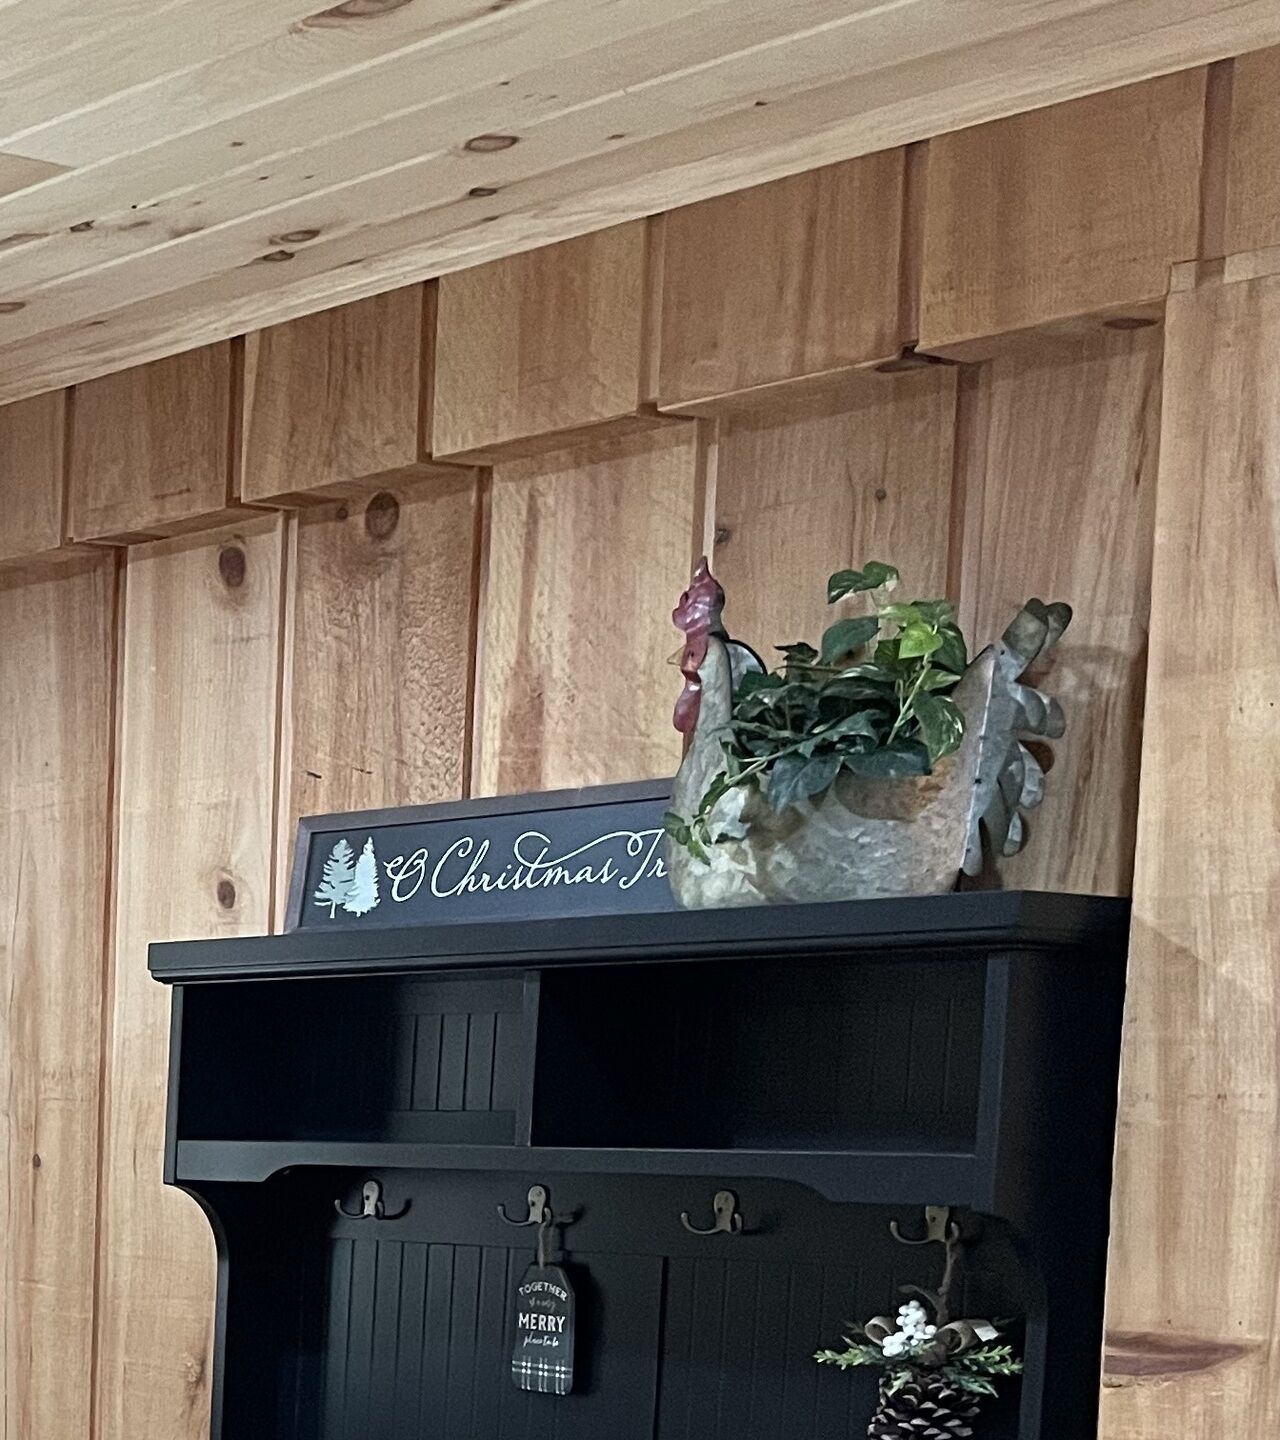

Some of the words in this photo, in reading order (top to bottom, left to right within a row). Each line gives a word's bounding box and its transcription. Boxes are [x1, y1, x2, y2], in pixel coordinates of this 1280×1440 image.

[430, 830, 619, 898] Christmas
[518, 1281, 567, 1301] TOGETHER
[518, 1312, 565, 1333] MERRY
